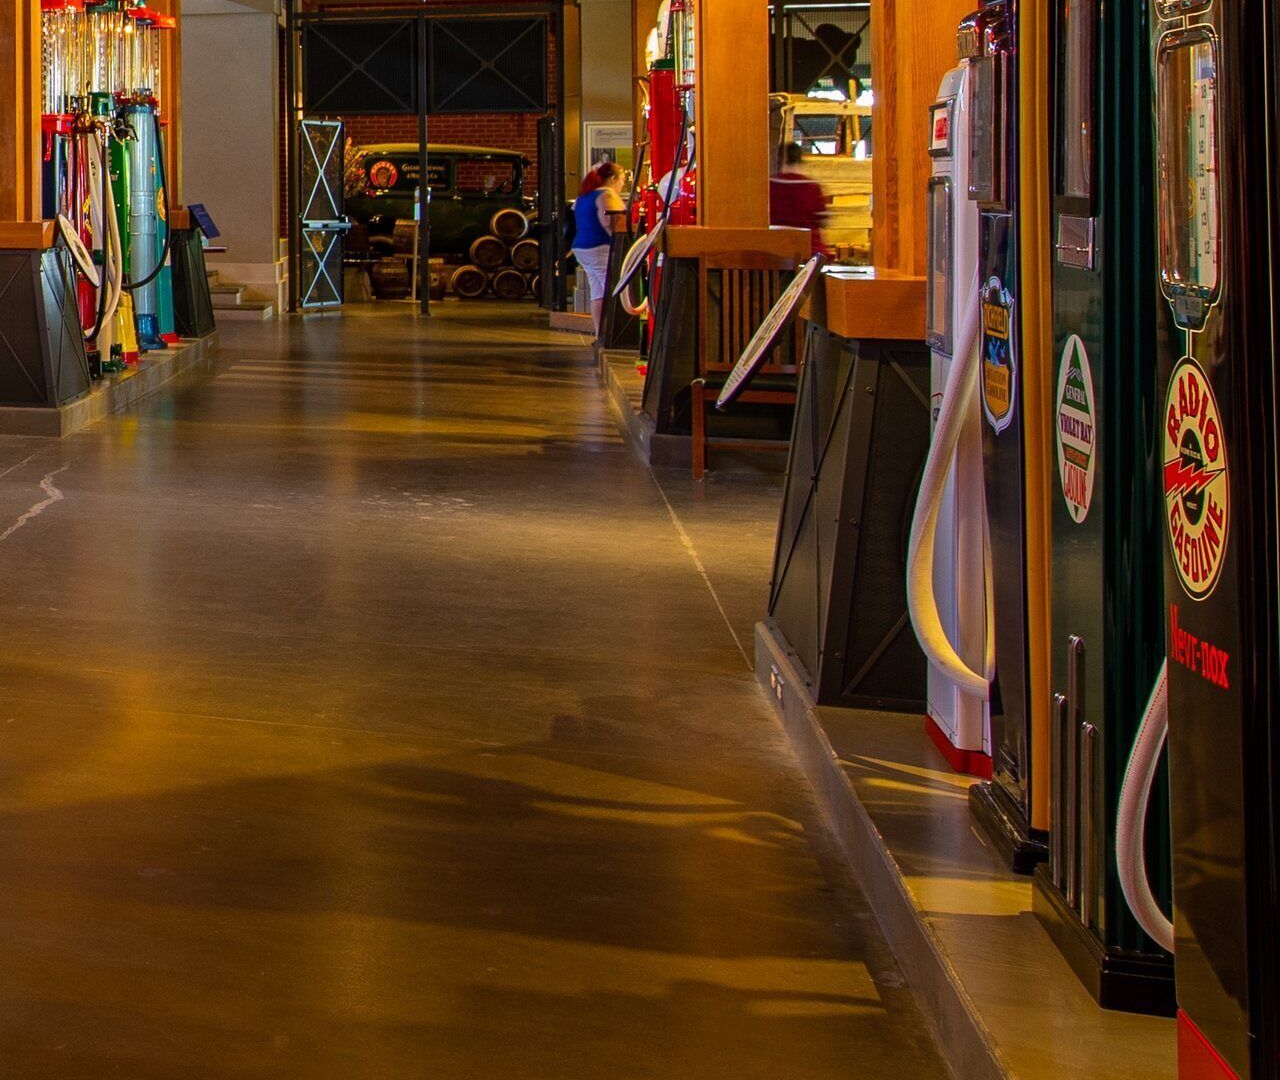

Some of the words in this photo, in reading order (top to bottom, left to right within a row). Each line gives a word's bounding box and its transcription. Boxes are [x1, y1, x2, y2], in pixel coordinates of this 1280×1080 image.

[1065, 384, 1086, 406] GENERAL
[1167, 372, 1219, 463] RADIO
[1060, 412, 1080, 443] VIOLET
[1080, 423, 1092, 445] RAY
[1064, 460, 1088, 510] GASOLINE
[1170, 492, 1223, 583] GASOLINE
